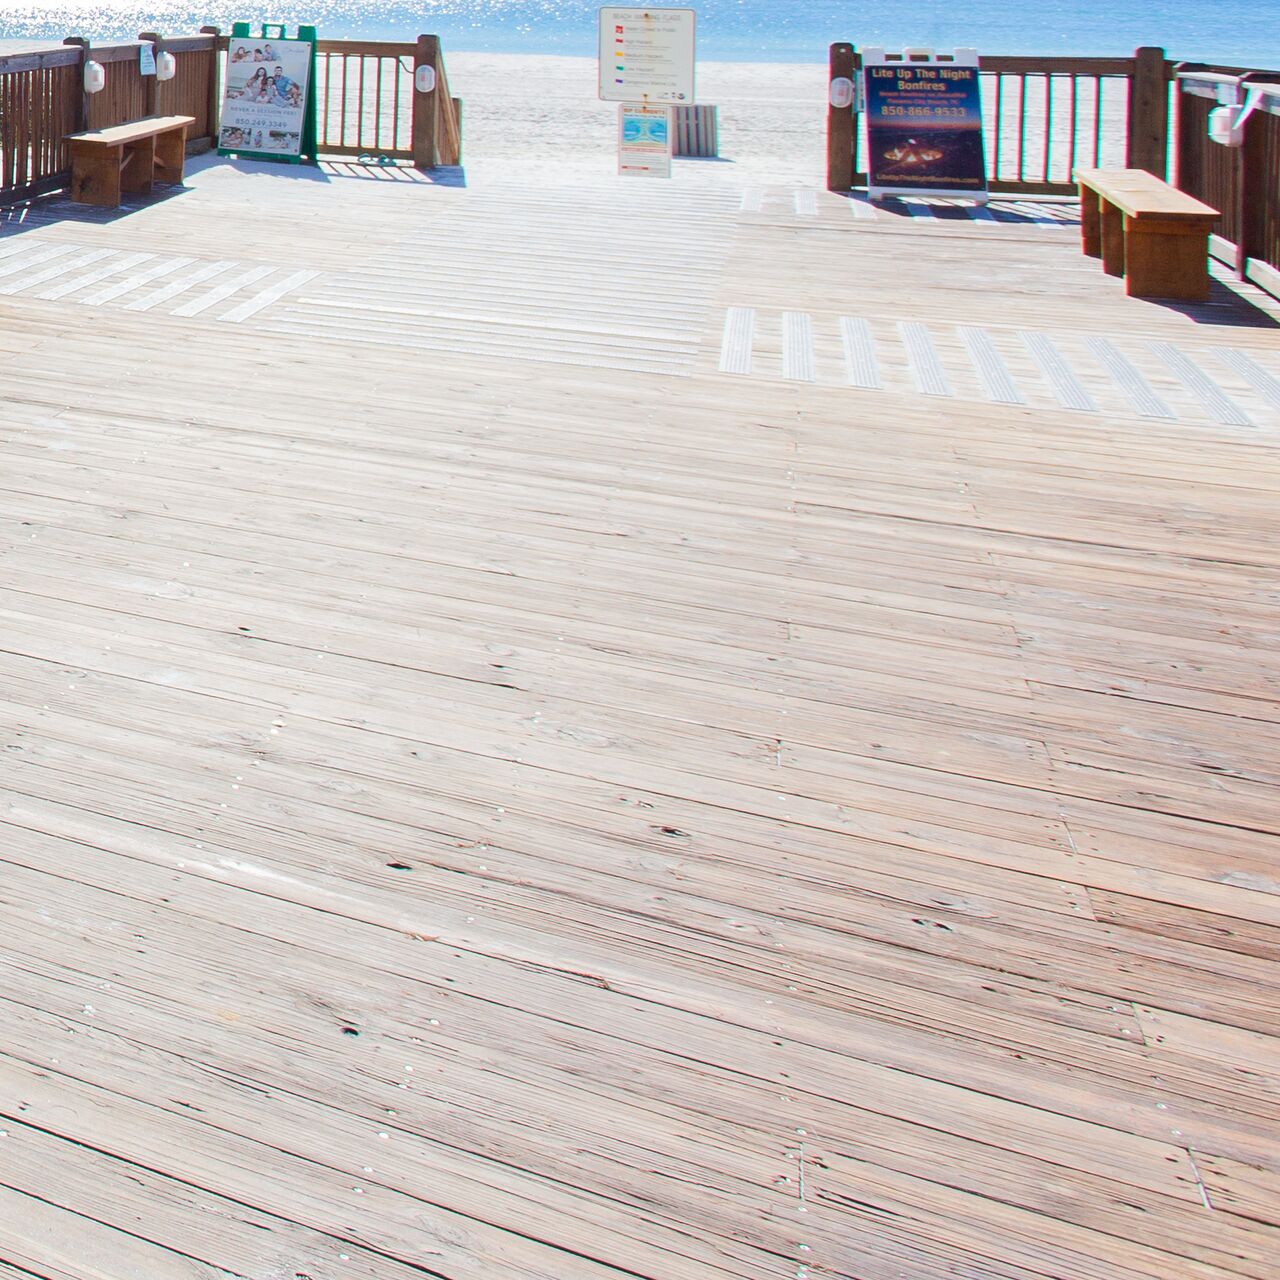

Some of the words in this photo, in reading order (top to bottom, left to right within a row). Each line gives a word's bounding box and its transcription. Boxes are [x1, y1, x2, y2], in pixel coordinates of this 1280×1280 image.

[872, 68, 894, 78] Lite
[897, 69, 912, 82] Up
[915, 68, 936, 79] The
[939, 69, 972, 81] Night
[897, 80, 947, 91] Bonfires
